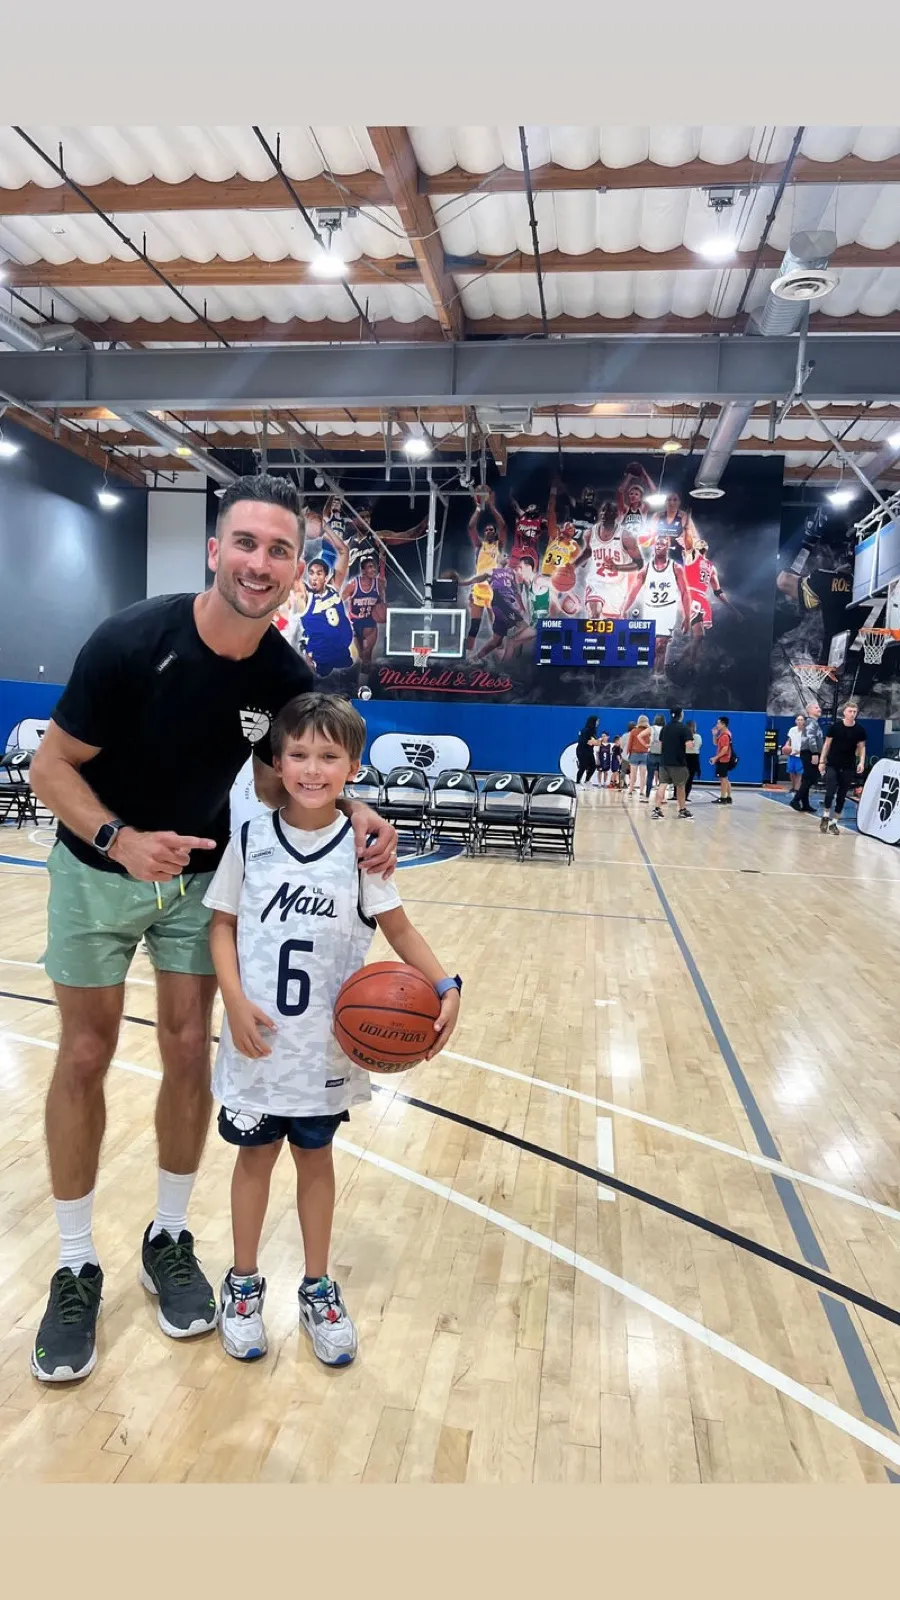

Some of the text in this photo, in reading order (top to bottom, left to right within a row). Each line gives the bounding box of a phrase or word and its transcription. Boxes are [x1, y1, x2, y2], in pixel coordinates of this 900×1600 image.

[649, 581, 671, 591] Mgic
[650, 592, 669, 604] 32
[542, 620, 562, 628] HOME
[586, 620, 614, 633] 5:03
[628, 621, 652, 630] GUEST
[378, 666, 514, 688] Mitchell & Ness
[312, 887, 325, 896] LIL
[260, 881, 338, 924] Mavs
[276, 938, 314, 1017] 6
[358, 1022, 427, 1043] EVOLUTION
